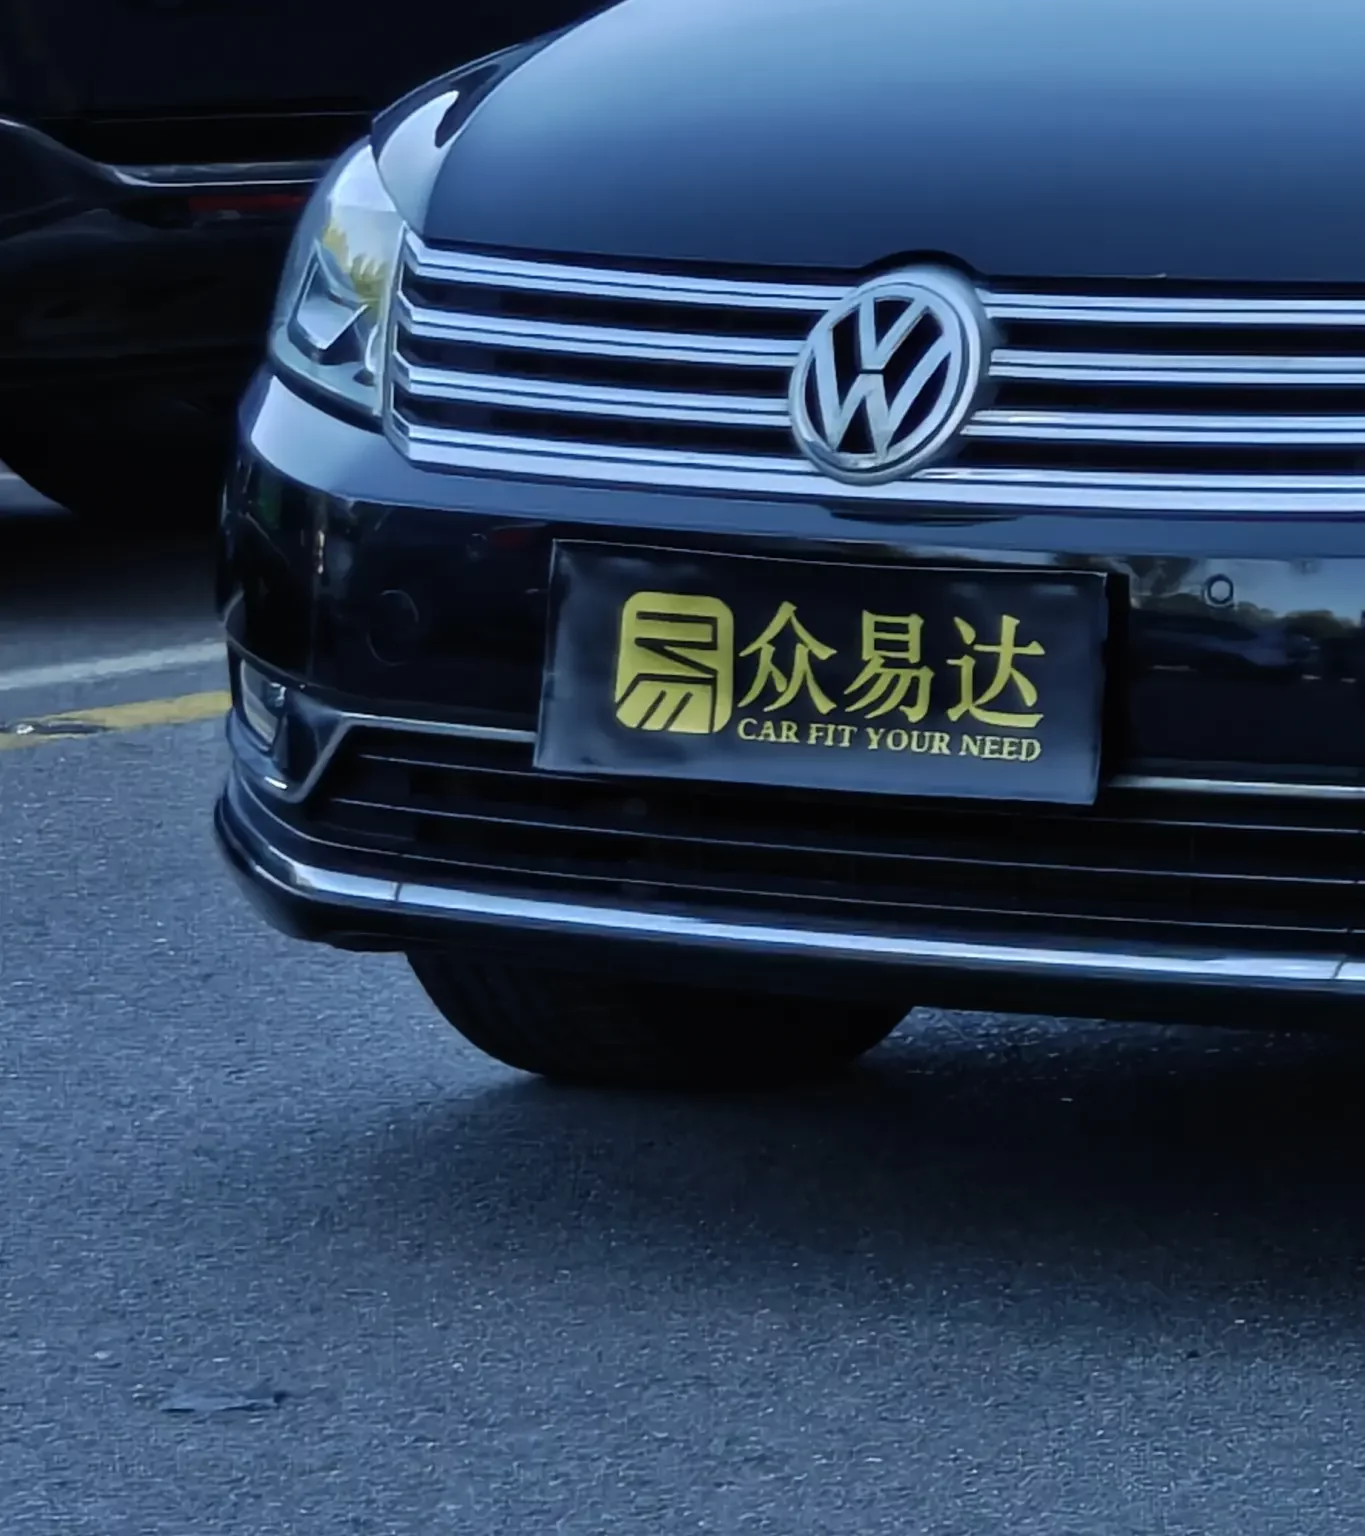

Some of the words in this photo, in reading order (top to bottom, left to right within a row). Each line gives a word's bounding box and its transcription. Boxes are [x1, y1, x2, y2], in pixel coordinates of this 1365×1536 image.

[737, 601, 1046, 729] 众易达
[737, 718, 800, 744] CAR
[807, 723, 858, 748] FIT
[865, 727, 951, 756] YOUR
[958, 733, 1043, 762] NEED
